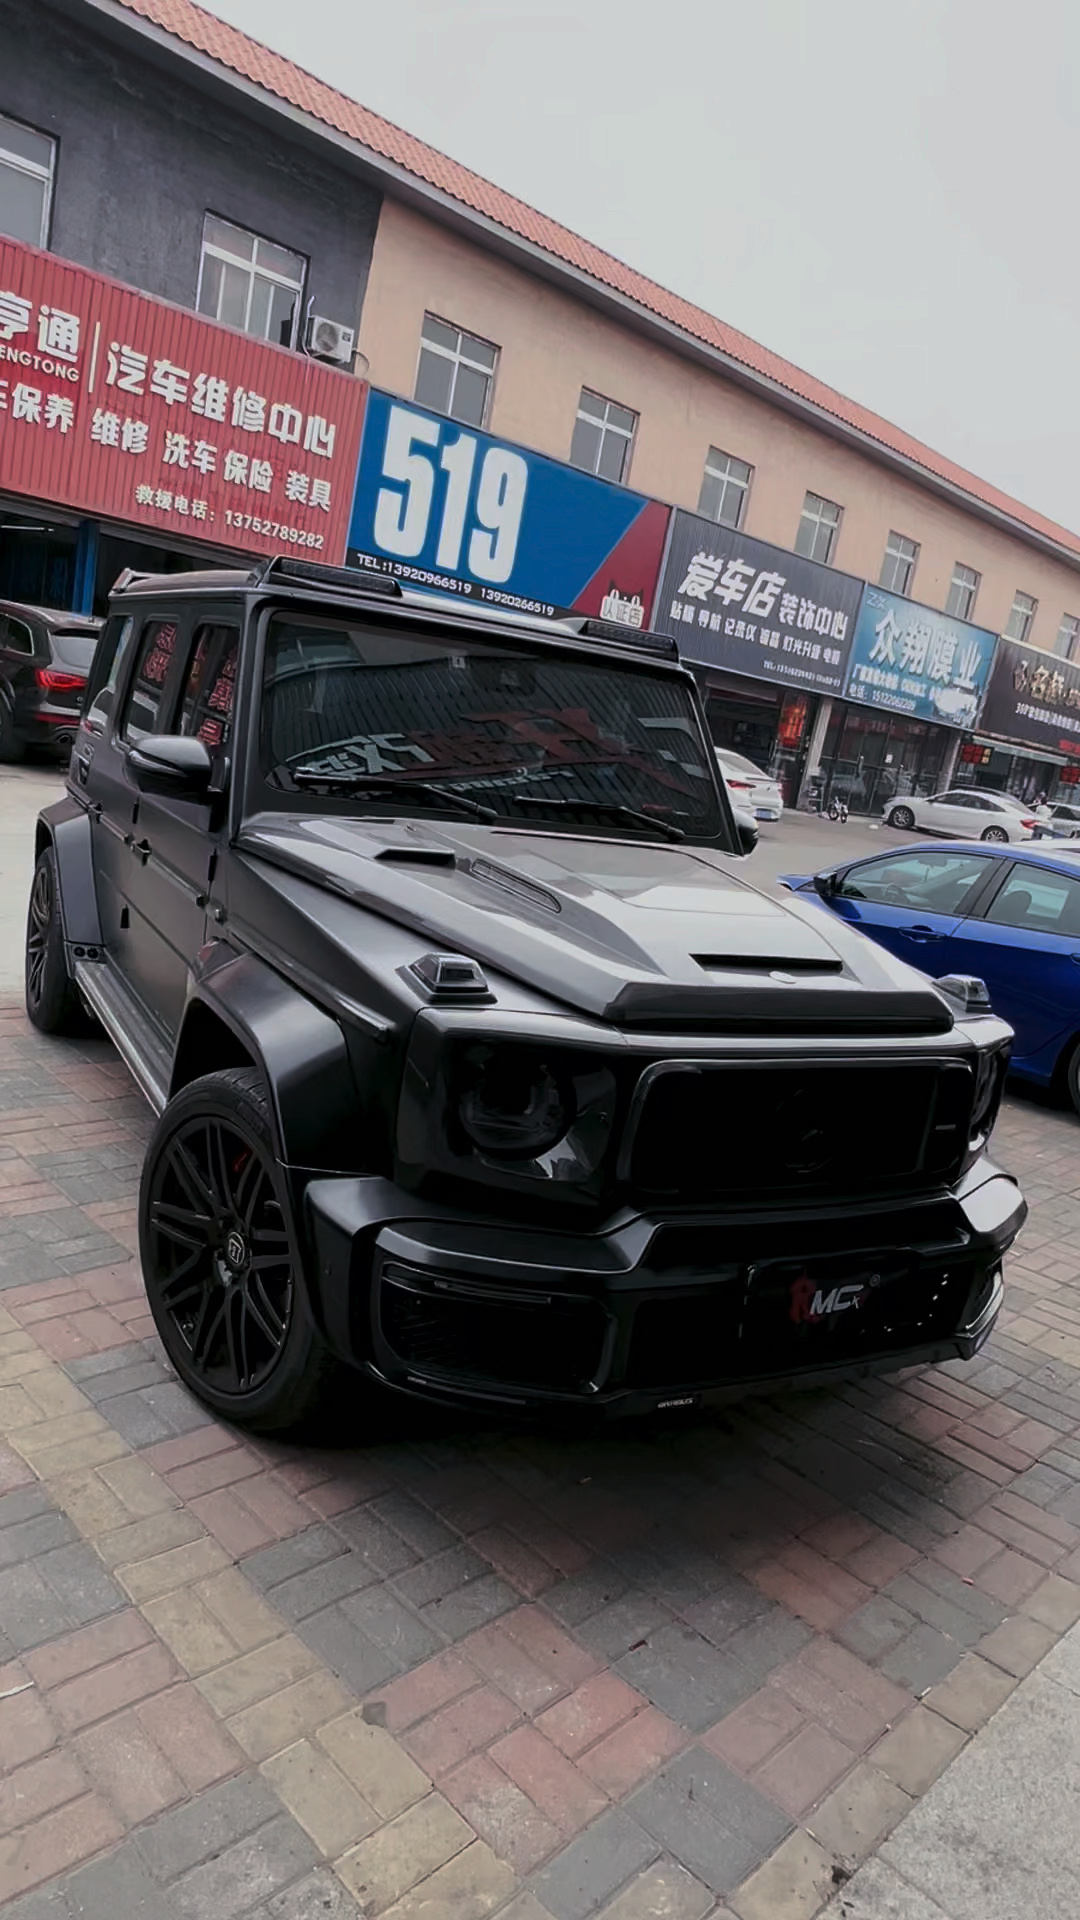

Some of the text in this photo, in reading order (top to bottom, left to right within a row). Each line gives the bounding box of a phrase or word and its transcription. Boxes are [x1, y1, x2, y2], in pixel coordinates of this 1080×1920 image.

[106, 342, 336, 459] 汽车维修中心
[0, 379, 332, 513] 保养 维修 洗车 保险 装具
[374, 405, 528, 583] 519
[480, 587, 555, 616] 13920266519
[677, 551, 849, 641] 爱车店 装饰中心
[724, 617, 758, 643] 记录仪
[868, 608, 982, 690] 众翔膜业
